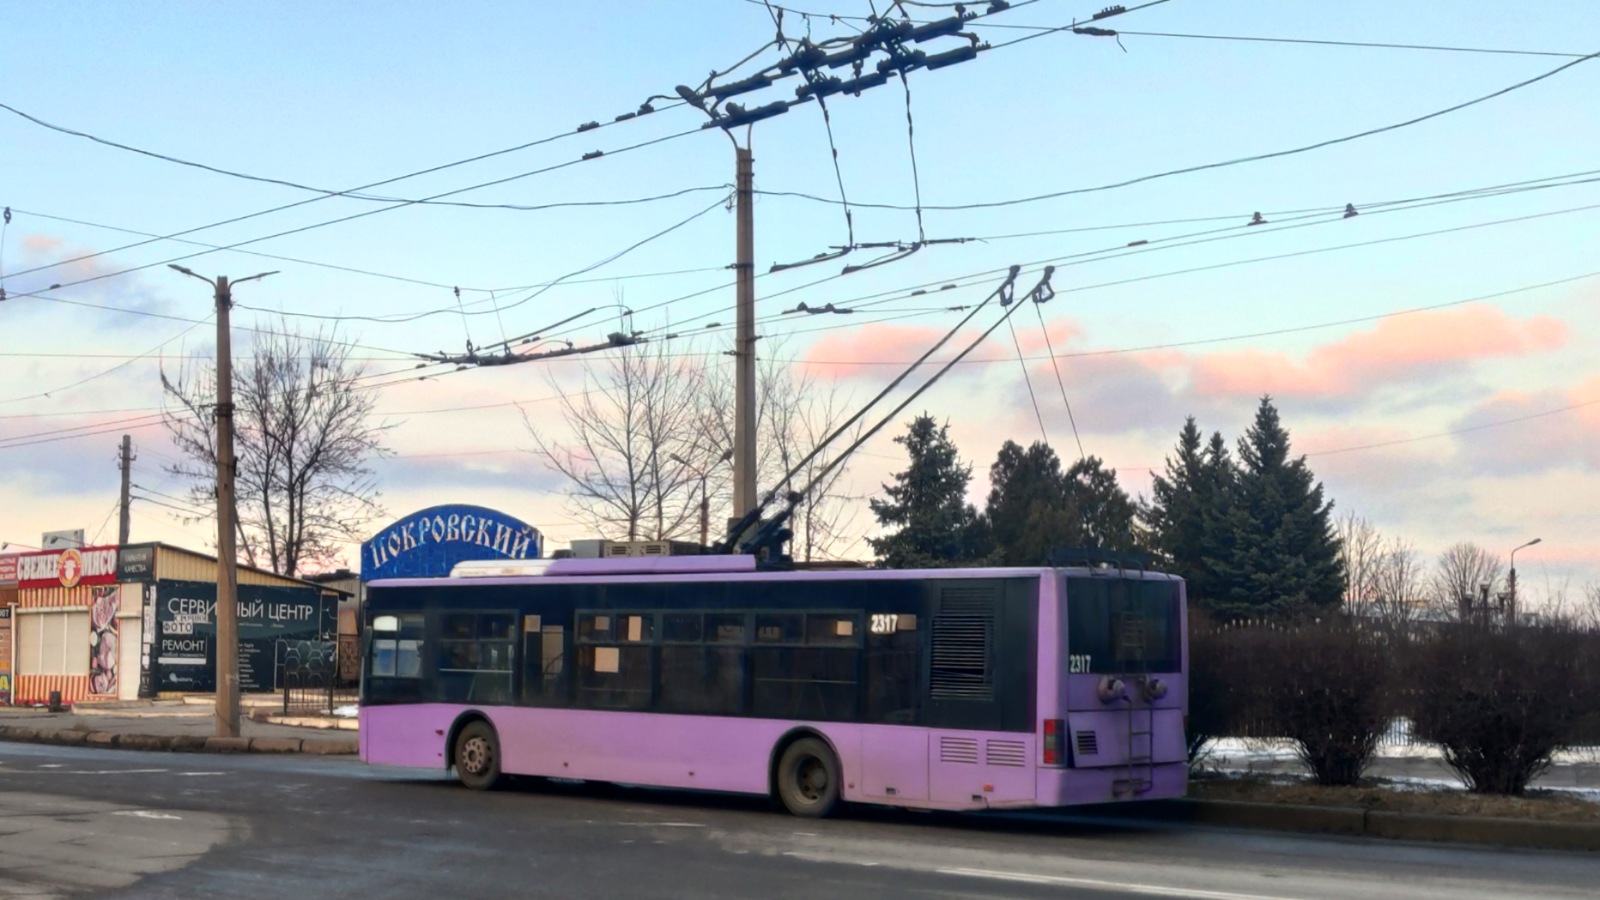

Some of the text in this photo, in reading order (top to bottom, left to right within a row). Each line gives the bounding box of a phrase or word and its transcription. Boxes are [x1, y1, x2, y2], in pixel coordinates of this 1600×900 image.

[369, 513, 532, 570] ПОКРОВСКИЙ
[17, 548, 117, 581] СВЕЖЕЕ МЯСО
[268, 602, 313, 621] ЦЕНТР
[163, 622, 193, 632] ФОТО
[871, 614, 898, 633] 2317
[162, 639, 205, 651] РЕМОНТ
[1070, 654, 1091, 673] 2317
